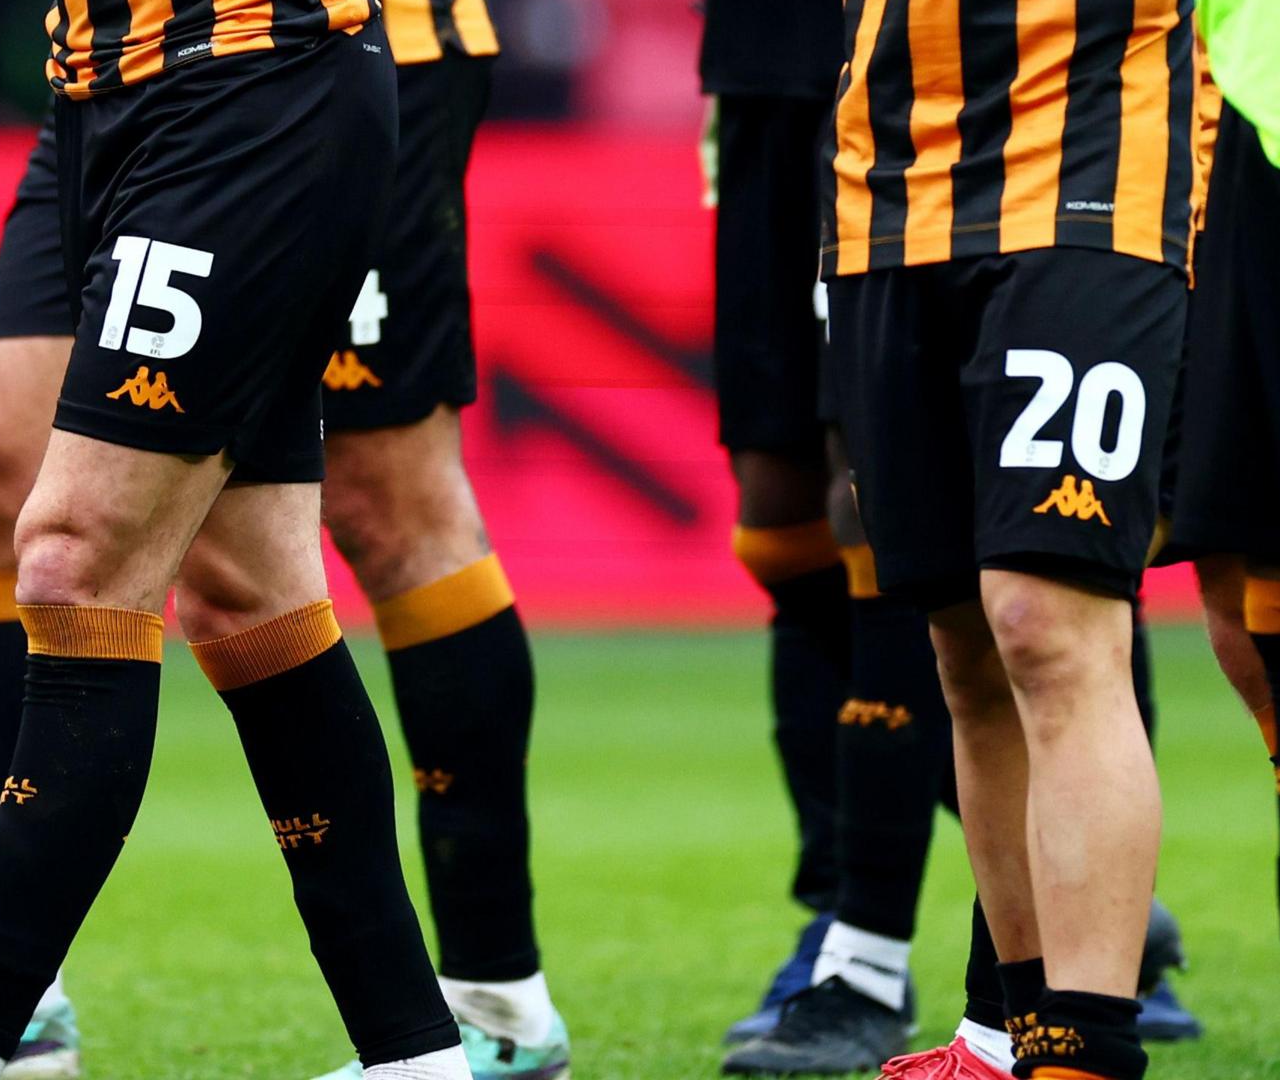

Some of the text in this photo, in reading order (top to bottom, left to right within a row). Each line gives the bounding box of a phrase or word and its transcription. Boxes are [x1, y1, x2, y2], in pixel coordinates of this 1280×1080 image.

[177, 41, 216, 57] KOMBA
[98, 235, 214, 360] 15
[999, 348, 1147, 482] 20
[276, 826, 329, 849] ITY
